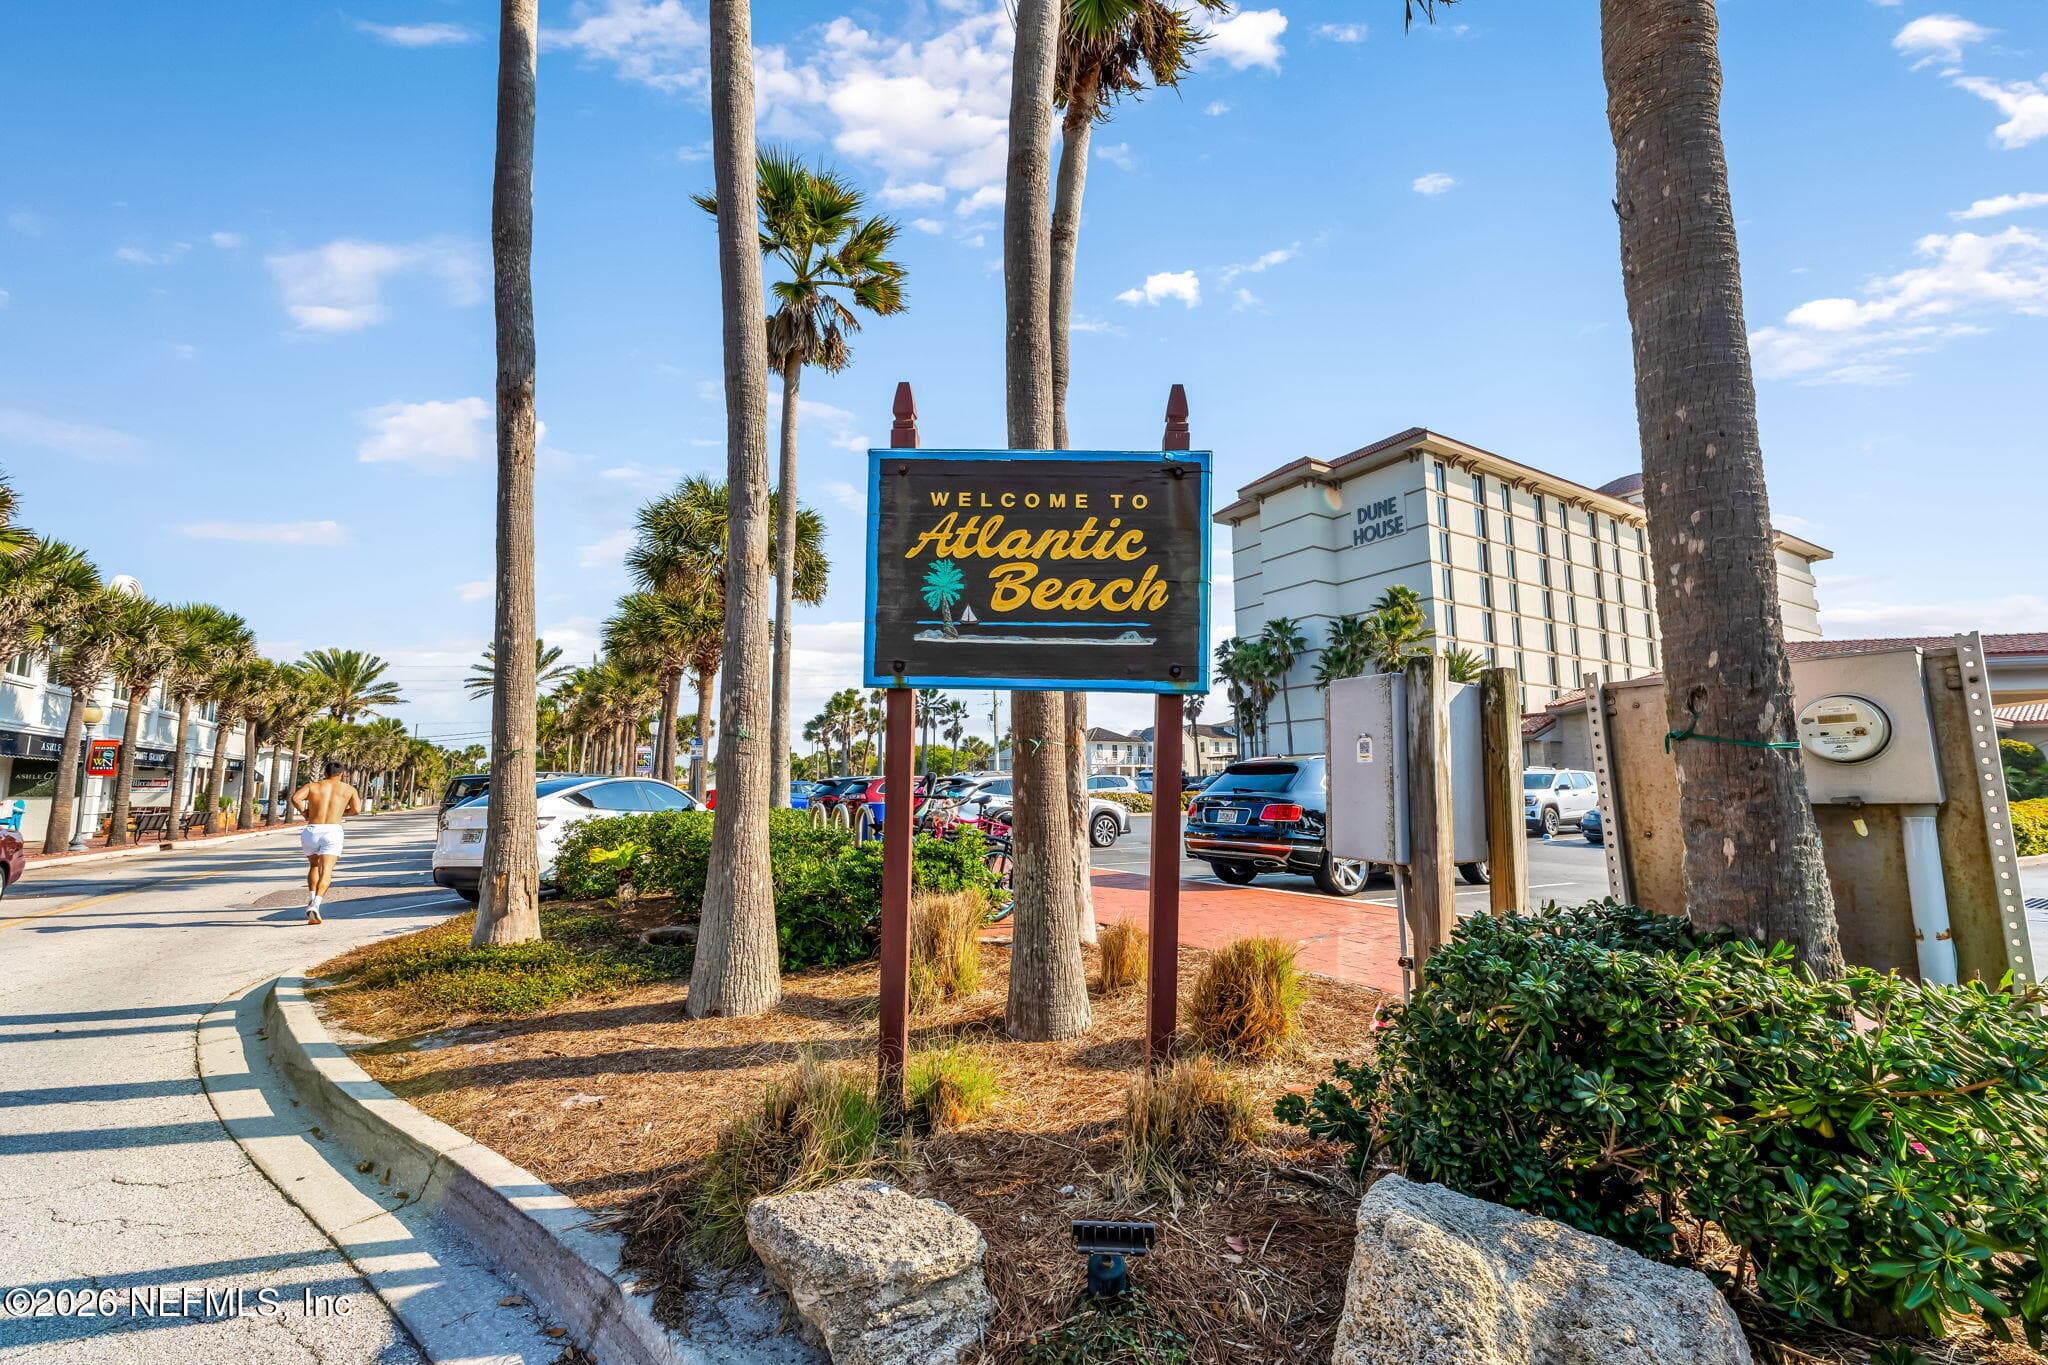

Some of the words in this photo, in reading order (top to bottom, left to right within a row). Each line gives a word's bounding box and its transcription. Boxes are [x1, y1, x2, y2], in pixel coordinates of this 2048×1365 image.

[930, 491, 1088, 509] WELCOME
[1110, 494, 1149, 509] TO
[1357, 496, 1398, 524] DUNE
[904, 511, 1147, 561] Atlantic
[1353, 515, 1404, 546] HOUSE
[988, 561, 1169, 612] Beach
[41, 742, 62, 751] ASHLE
